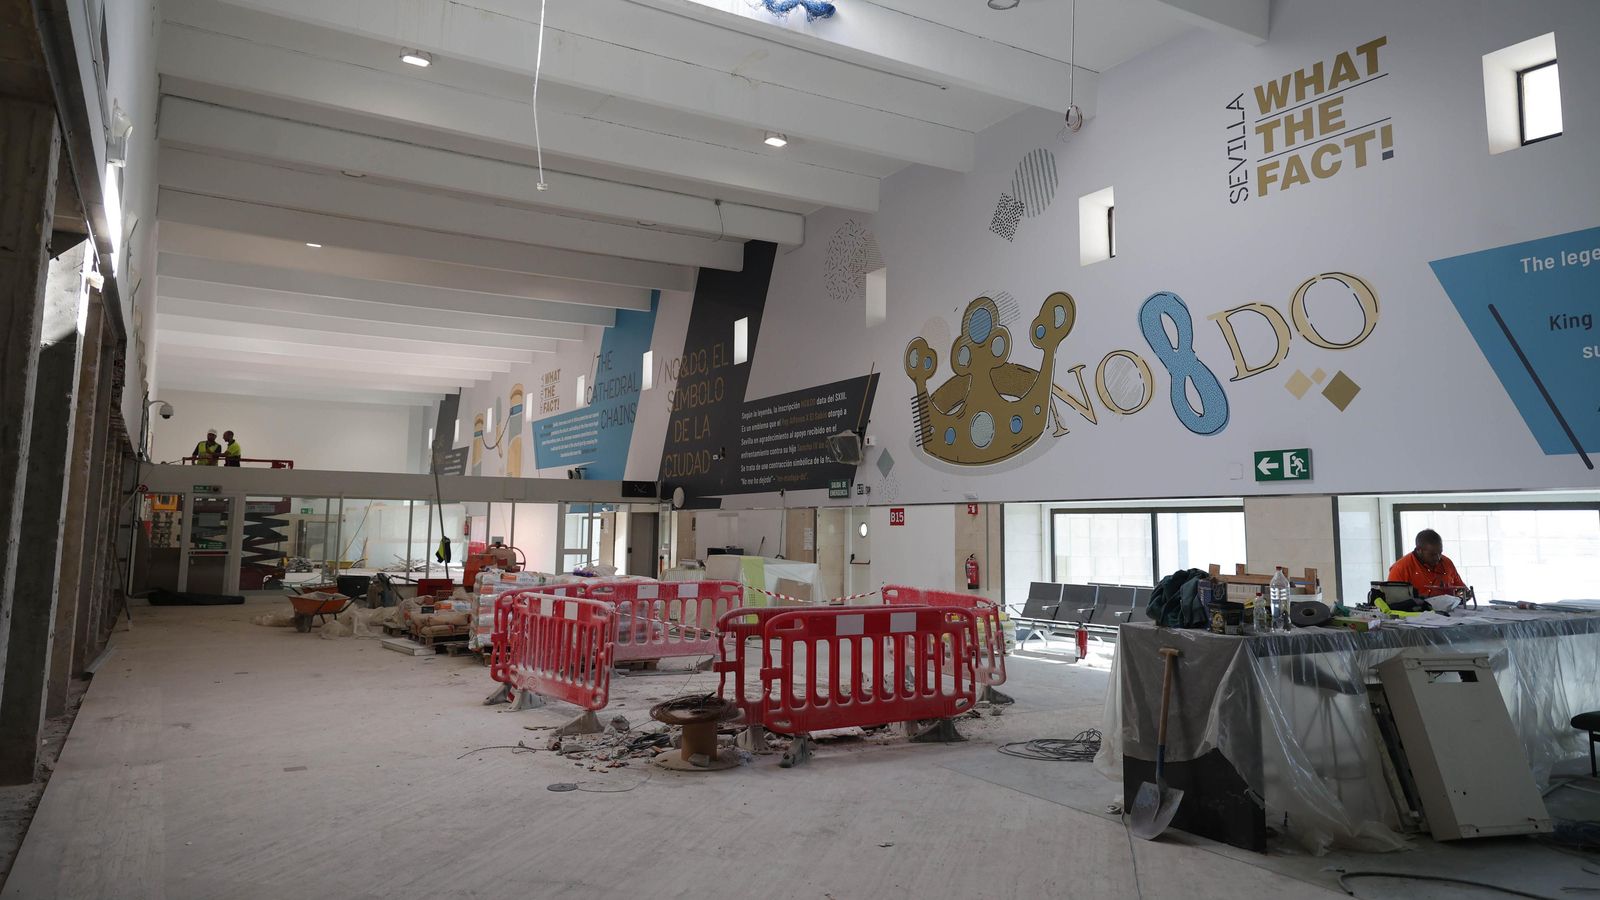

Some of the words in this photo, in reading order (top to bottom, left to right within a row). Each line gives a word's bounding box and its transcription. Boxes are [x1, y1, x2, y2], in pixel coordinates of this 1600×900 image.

[1253, 35, 1387, 115] WHAT
[1255, 95, 1346, 154] THE
[1226, 93, 1249, 204] SEVILLA
[1257, 123, 1394, 197] FACT!
[1520, 256, 1555, 274] The
[1549, 313, 1593, 331] King
[713, 343, 729, 369] EL
[545, 369, 561, 385] WHAT
[544, 384, 556, 399] THE
[587, 372, 639, 405] CATHEDRAL
[543, 398, 560, 413] FACT!
[778, 400, 800, 412] inscripción
[816, 397, 826, 405] data
[601, 402, 636, 430] CHAINS
[675, 417, 690, 442] DE
[695, 414, 711, 440] LA
[759, 433, 789, 445] agradecimiento
[794, 430, 806, 439] apoyo
[807, 426, 825, 435] recibido
[665, 449, 711, 478] CIUDAD
[741, 450, 769, 459] enfrentamiento
[769, 460, 792, 468] contracción
[793, 457, 813, 466] simbólica
[814, 456, 819, 464] de
[820, 456, 824, 464] la
[890, 511, 904, 523] B15
